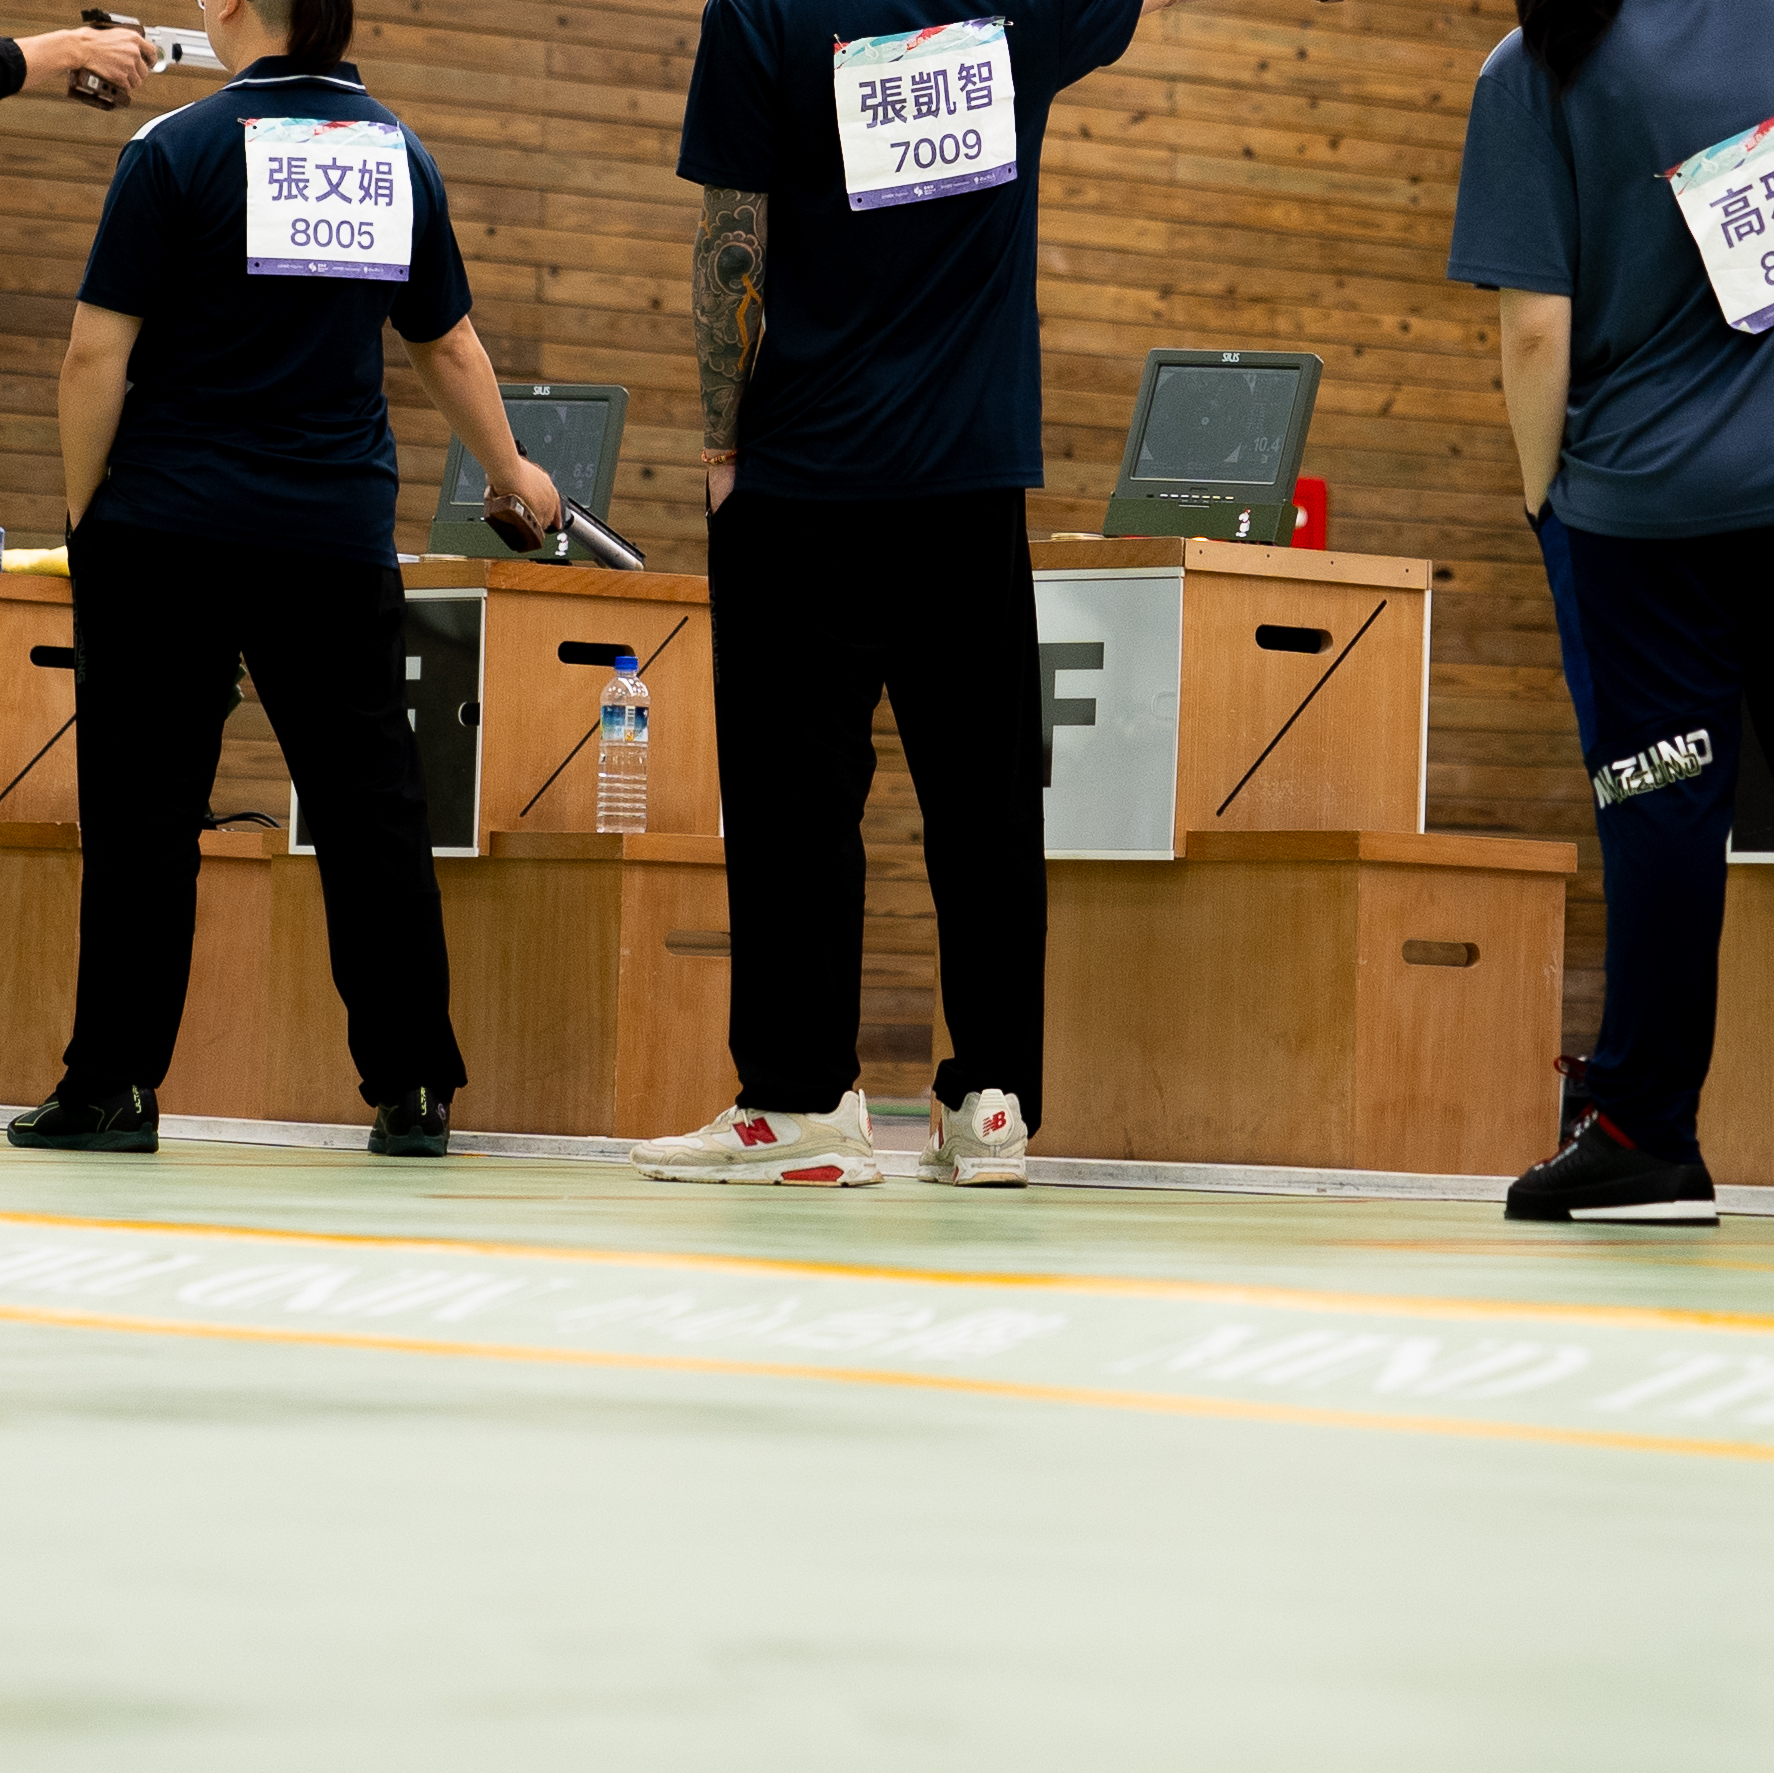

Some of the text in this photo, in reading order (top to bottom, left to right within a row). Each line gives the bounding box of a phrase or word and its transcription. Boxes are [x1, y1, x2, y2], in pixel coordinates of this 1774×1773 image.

[859, 60, 994, 130] 張凱智
[890, 129, 982, 173] 7009
[268, 156, 394, 207] 張文娟
[290, 217, 375, 250] 8005
[1222, 352, 1240, 362] SIUS
[533, 385, 551, 396] SIUS
[1041, 641, 1104, 788] F
[1103, 1322, 1593, 1401] MIND
